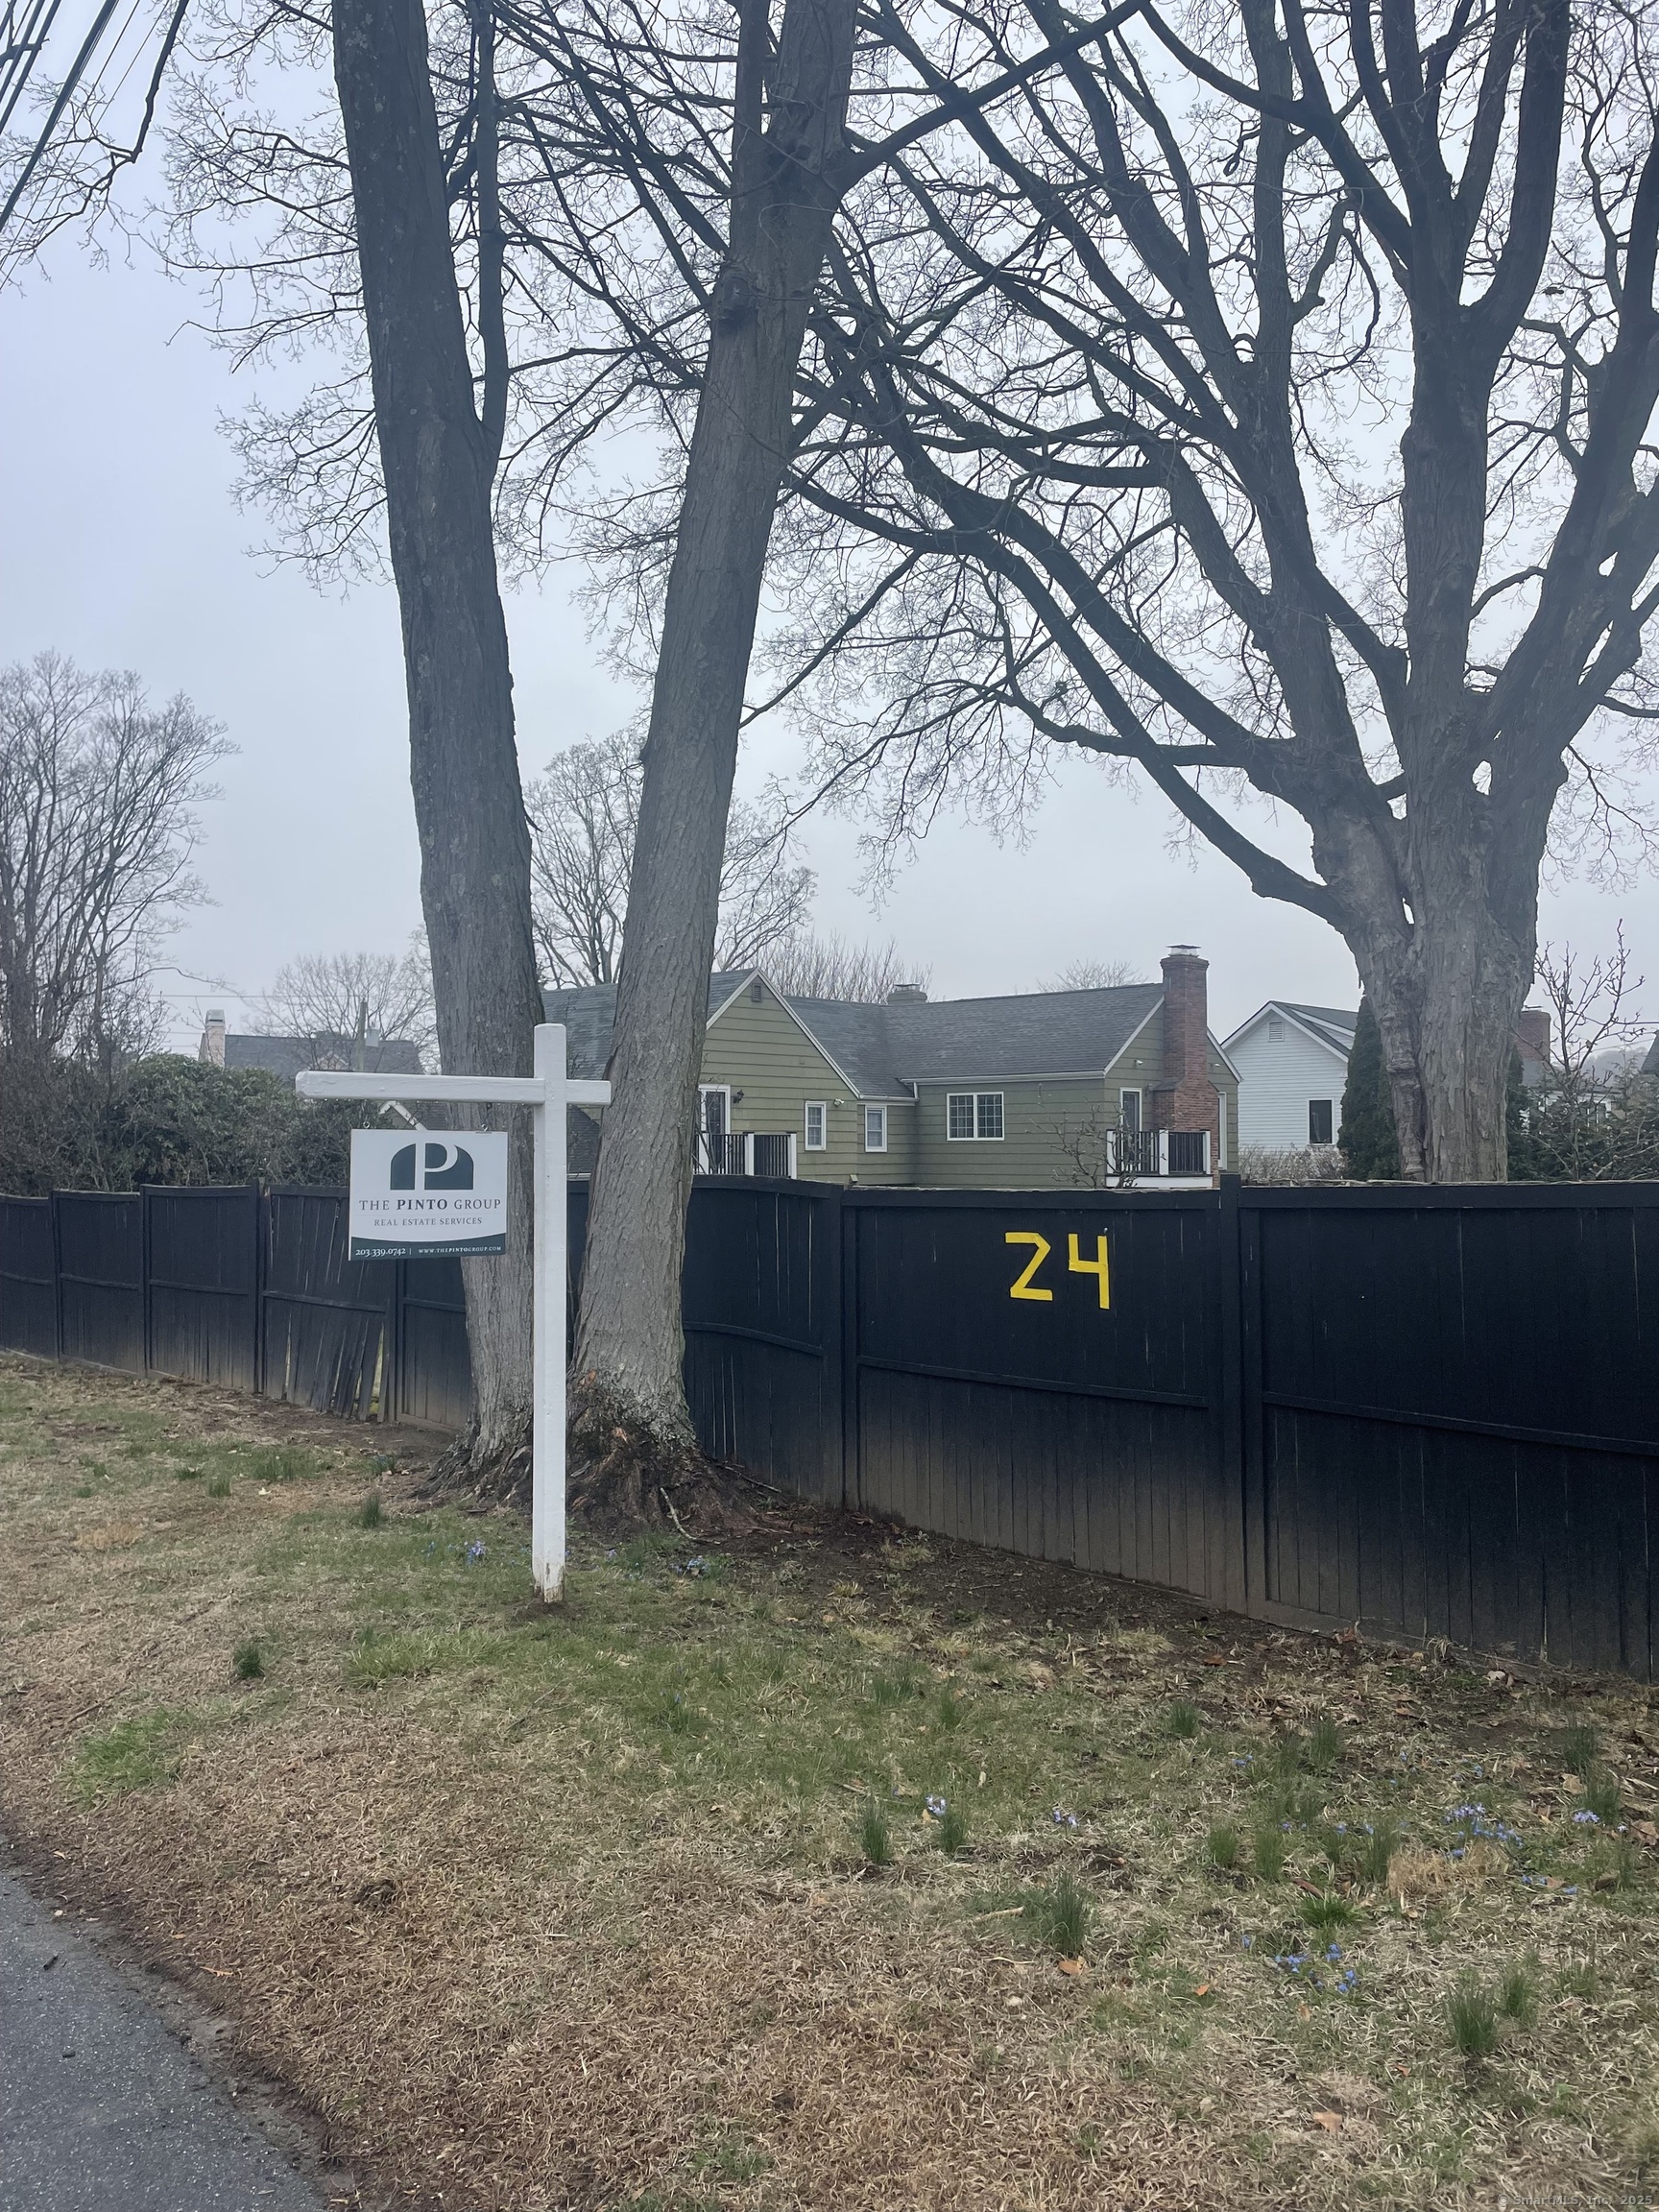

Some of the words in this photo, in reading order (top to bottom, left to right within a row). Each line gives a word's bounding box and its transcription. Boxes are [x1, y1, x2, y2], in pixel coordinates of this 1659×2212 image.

[415, 1142, 458, 1190] P
[359, 1200, 390, 1211] THE
[397, 1198, 448, 1211] PINTO
[454, 1198, 501, 1210] GROUP
[374, 1218, 398, 1227] REAL
[402, 1217, 436, 1226] ESTATE
[439, 1217, 482, 1226] SERVICES
[355, 1247, 406, 1258] 203.339.0742
[1005, 1232, 1110, 1310] 24
